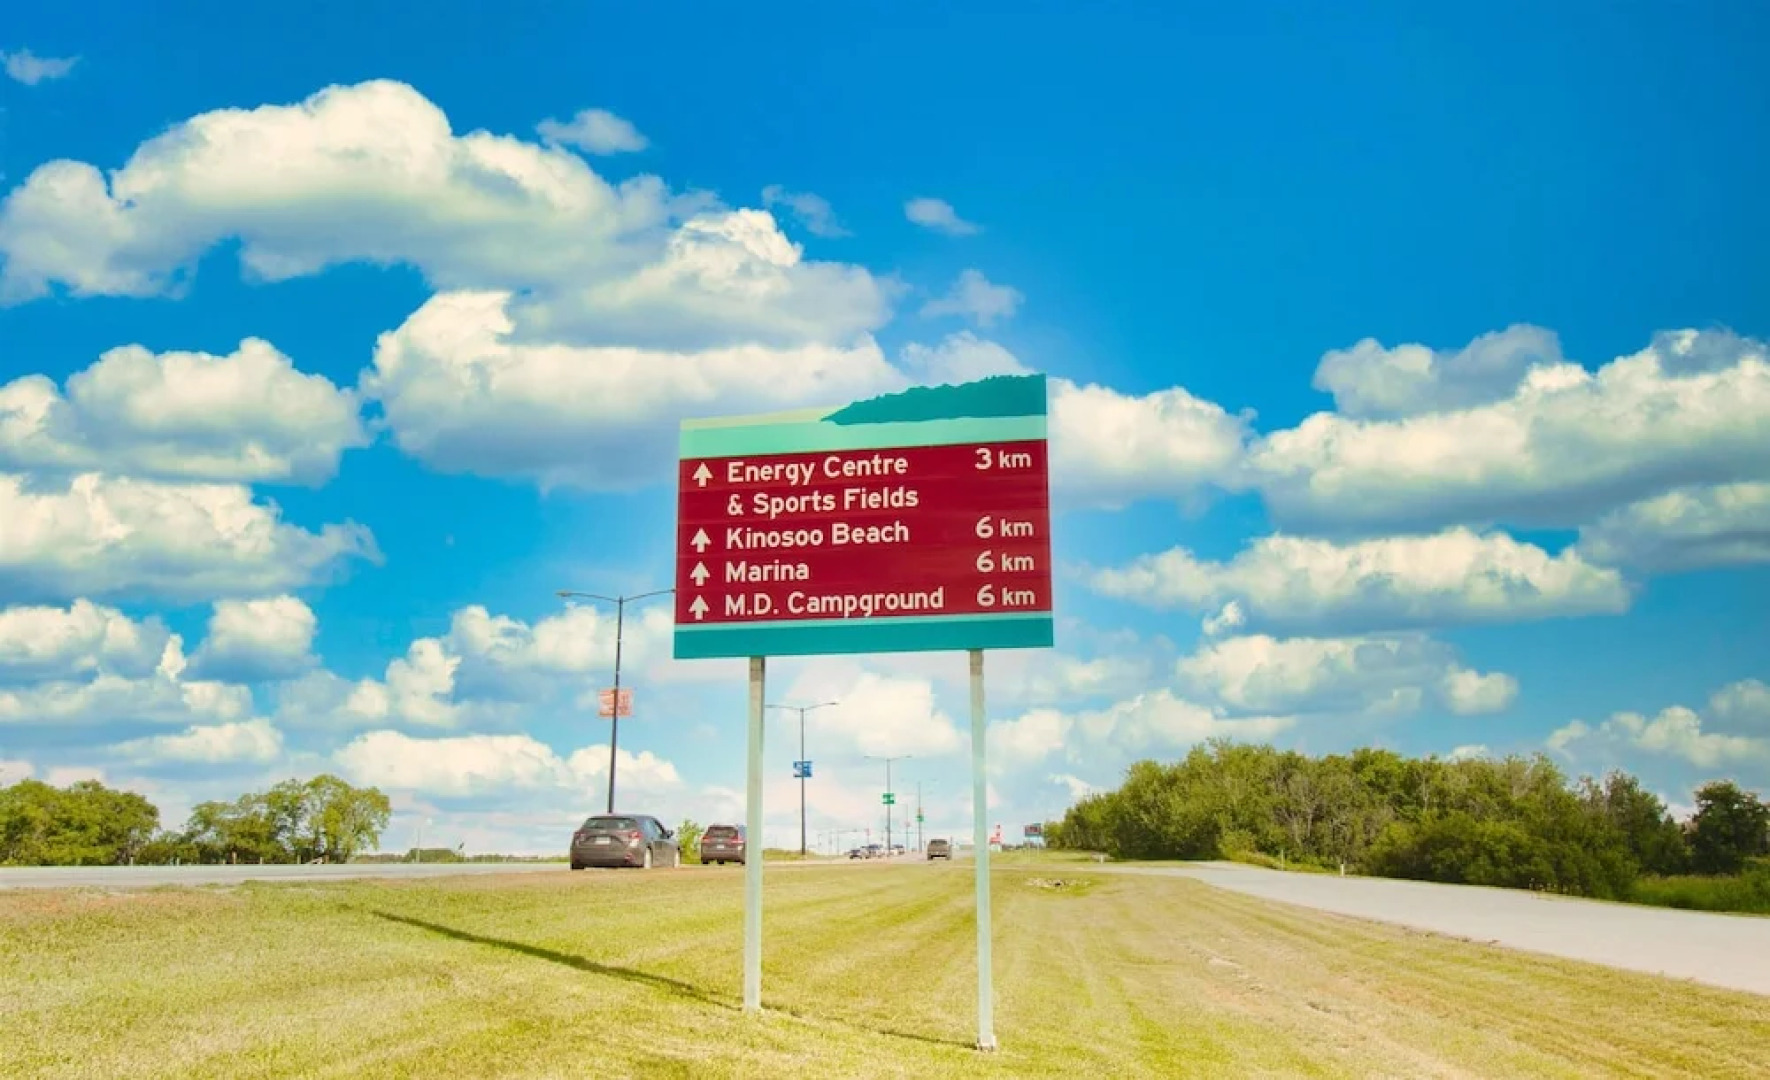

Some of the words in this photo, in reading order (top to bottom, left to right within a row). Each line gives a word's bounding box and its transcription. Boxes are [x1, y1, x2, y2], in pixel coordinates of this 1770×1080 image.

[975, 448, 992, 469] 3
[1000, 451, 1030, 467] km
[728, 462, 814, 485] Energy
[824, 455, 908, 478] Centre
[728, 494, 743, 515] &
[754, 491, 835, 519] Sports
[844, 487, 918, 510] Fields
[727, 528, 823, 549] Kinosoo
[832, 521, 908, 544] Beach
[976, 517, 993, 538] 6
[1001, 519, 1032, 536] km
[726, 560, 809, 582] Marina
[977, 551, 994, 572] 6
[1002, 554, 1034, 571] km
[726, 593, 778, 616] M.D.
[788, 587, 944, 617] Campground
[977, 584, 995, 606] 6
[1002, 588, 1034, 605] km
